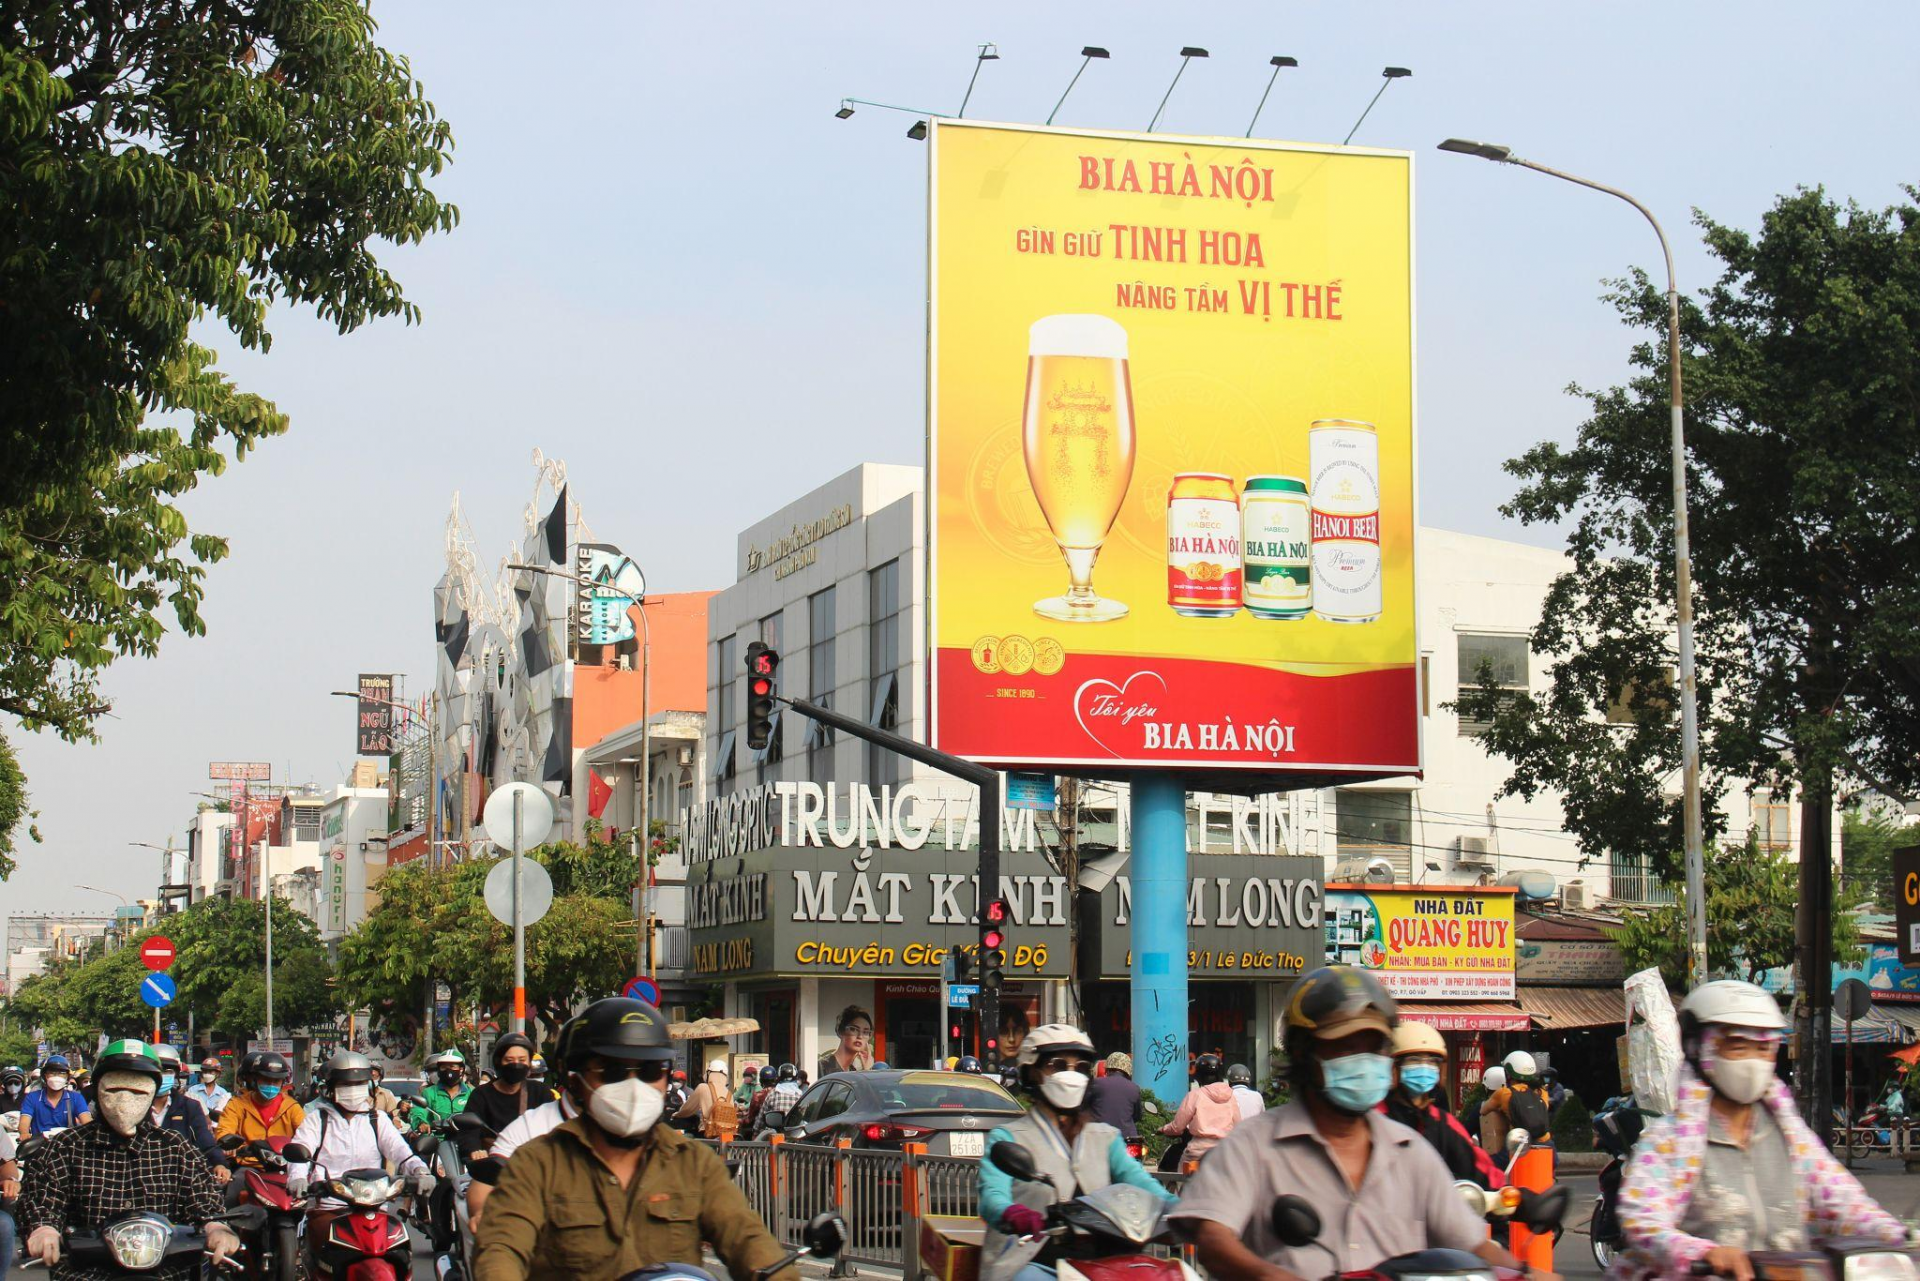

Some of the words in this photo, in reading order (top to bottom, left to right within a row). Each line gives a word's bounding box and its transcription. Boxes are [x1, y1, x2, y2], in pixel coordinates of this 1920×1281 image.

[1078, 155, 1143, 193] BIA
[1149, 151, 1203, 197] HÀ
[1209, 157, 1275, 208] NỘI
[1016, 225, 1055, 255] GÌN
[1063, 229, 1103, 258] GIỮ
[1109, 224, 1187, 264] TINH
[1199, 229, 1265, 268] HOA
[1116, 280, 1177, 311] NÂNG
[1184, 281, 1229, 314] TẦM
[1238, 279, 1272, 322] VỊ
[1280, 278, 1345, 321] THẾ
[1313, 512, 1352, 538] HANOI
[1352, 514, 1379, 541] BEER
[1169, 536, 1188, 553] BIA
[1192, 532, 1215, 554] HÀ
[1217, 536, 1240, 561] NỘI
[1246, 540, 1266, 556] BIA
[1266, 538, 1288, 558] HÀ
[1292, 540, 1308, 560] NỘI
[579, 548, 593, 639] KARAOKE
[996, 688, 1017, 699] SINCE
[1018, 689, 1035, 699] 1890
[1089, 694, 1122, 717] Tôi
[1121, 703, 1158, 725] yêu
[1143, 722, 1194, 750] BIA
[1197, 715, 1240, 751] HÀ
[1244, 717, 1296, 758] NỘI
[775, 780, 933, 850] TRUNG
[687, 860, 720, 930] MẮT
[721, 857, 765, 925] KÍNH
[792, 846, 912, 923] MẮT
[986, 901, 1004, 921] 15
[1216, 876, 1322, 929] LONG
[1414, 896, 1449, 915] NHÀ
[1453, 894, 1485, 915] ĐẤT
[1388, 917, 1462, 953] QUANG
[1466, 919, 1510, 949] HUY
[693, 942, 718, 974] NAM
[721, 937, 753, 971] LONG
[795, 940, 895, 971] Chuyên
[902, 942, 948, 966] Gia
[1013, 942, 1048, 972] Độ
[1216, 950, 1235, 968] Lê
[1240, 949, 1273, 969] Đức
[1278, 951, 1305, 974] Thọ
[1413, 956, 1431, 967] MUA
[1497, 955, 1511, 969] ĐẤT
[886, 984, 905, 993] Kính
[905, 984, 928, 993] Chào
[928, 985, 941, 994] Qu
[1439, 1015, 1454, 1028] NHÀ
[1454, 1014, 1468, 1029] ĐẤT
[1459, 1046, 1482, 1062] MUA
[951, 1143, 984, 1155] 251.80
[957, 1132, 976, 1143] 72A
